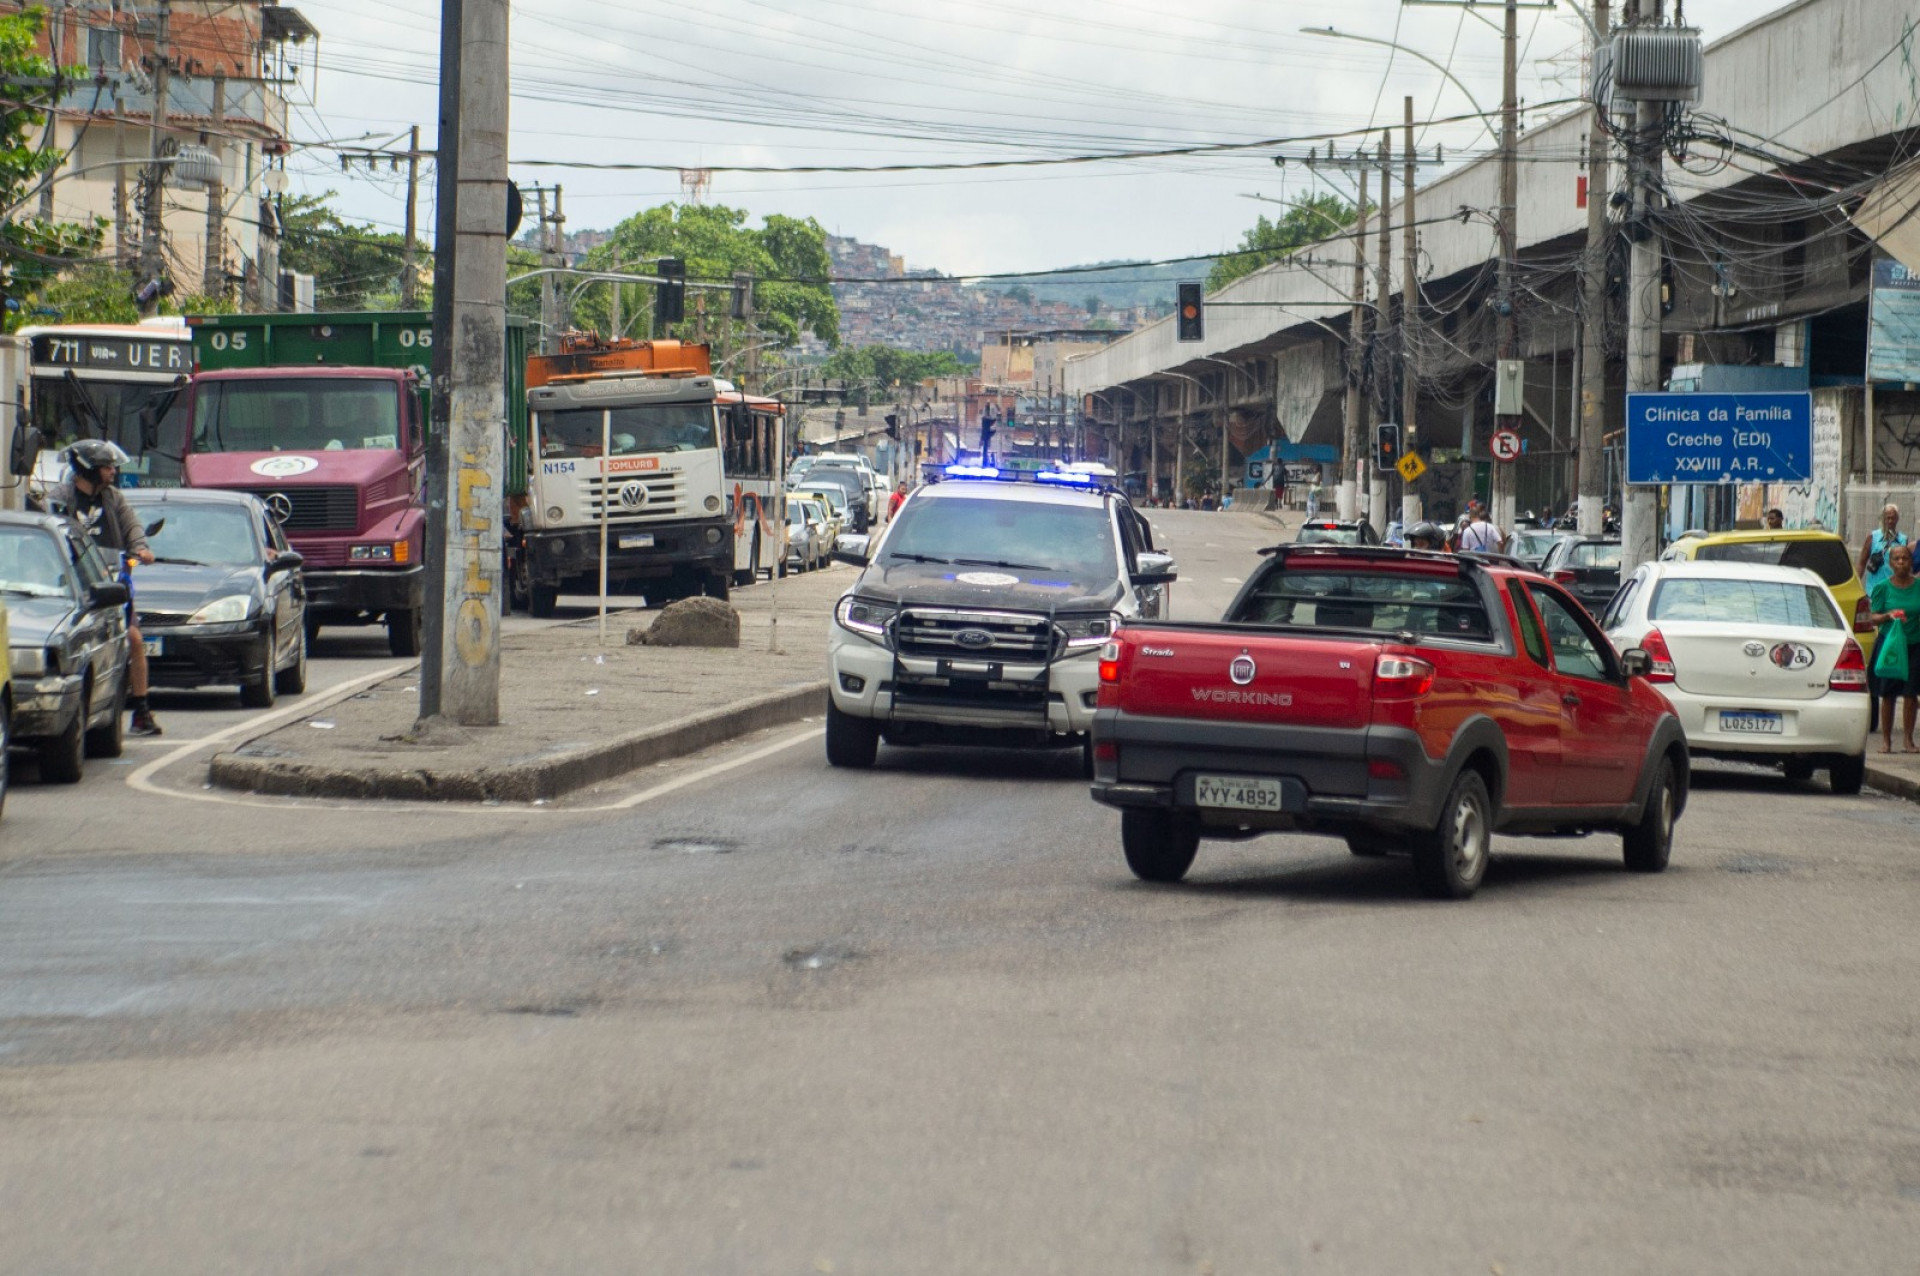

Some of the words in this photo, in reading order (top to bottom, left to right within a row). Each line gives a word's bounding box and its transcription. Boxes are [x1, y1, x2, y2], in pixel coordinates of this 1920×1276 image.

[211, 331, 247, 350] 05
[399, 329, 432, 347] 05
[50, 339, 79, 362] 711
[128, 343, 192, 368] UER
[1645, 406, 1700, 422] Clínica
[1708, 407, 1728, 422] da
[1735, 405, 1792, 421] Família
[1666, 432, 1723, 447] Creche
[1733, 431, 1771, 449] (EDI)
[544, 461, 576, 475] N154
[1675, 457, 1721, 471] XXVIII
[1730, 457, 1763, 471] A.R.
[961, 632, 985, 645] Ford
[1141, 646, 1175, 657] Strada
[1235, 664, 1251, 678] FIAT
[1191, 688, 1293, 706] WORKING
[1199, 786, 1277, 807] KYY-4892
